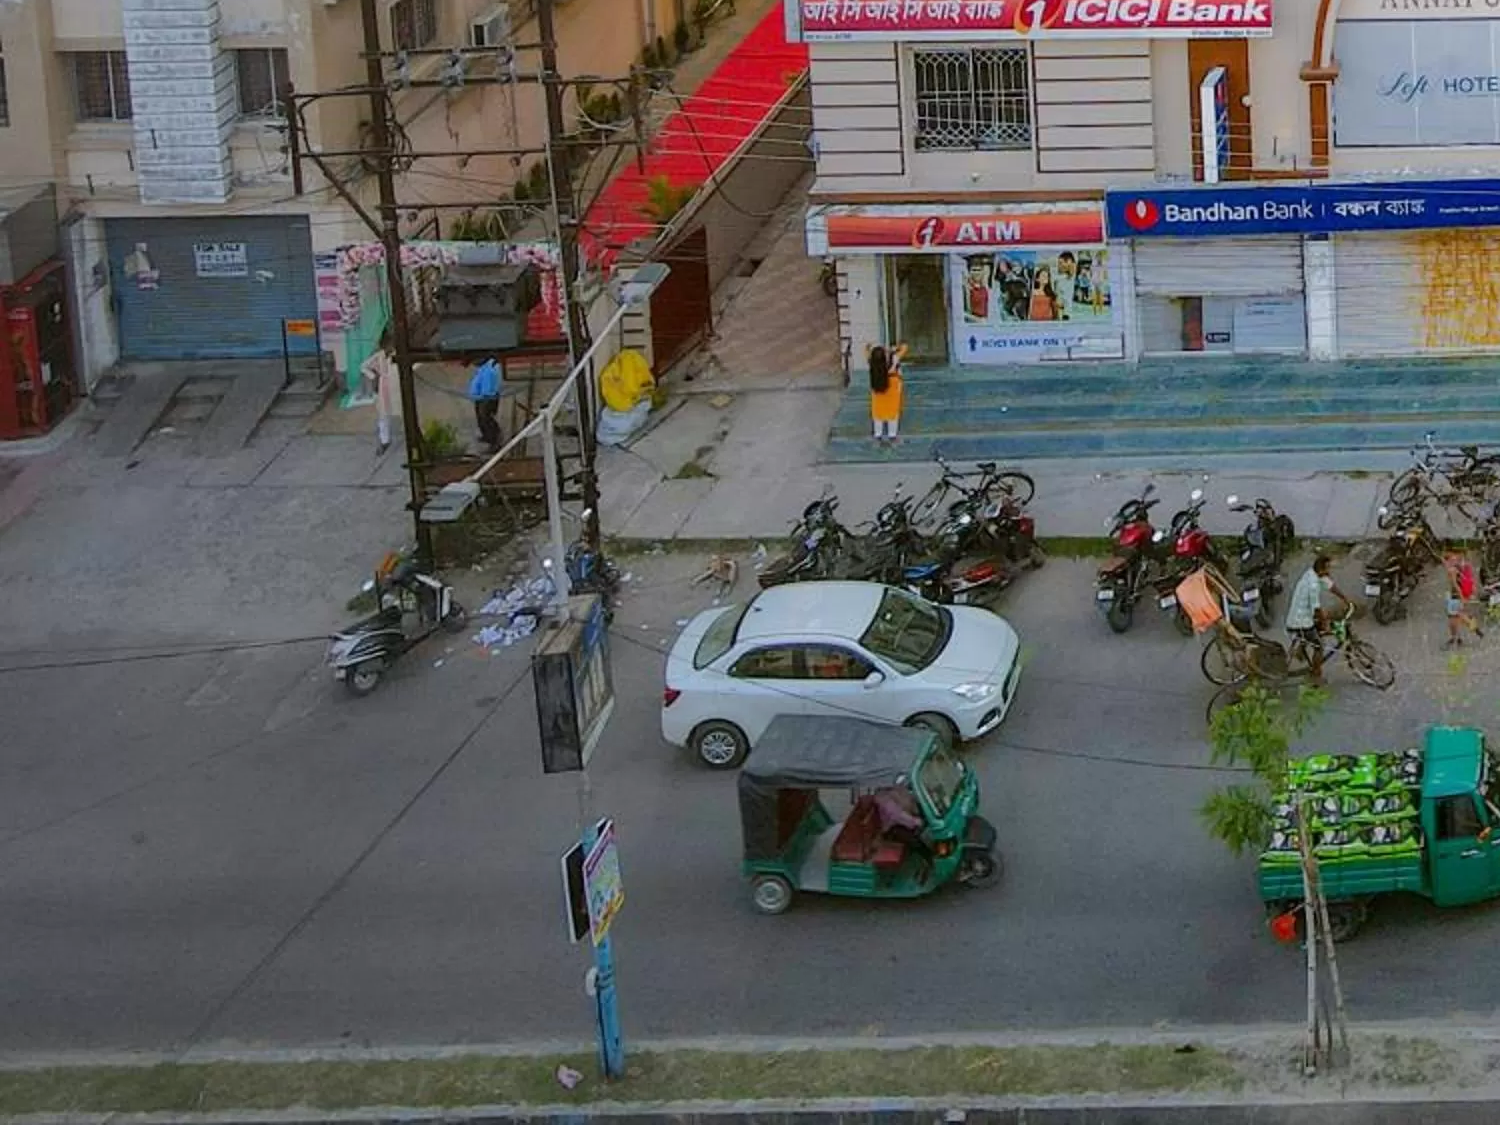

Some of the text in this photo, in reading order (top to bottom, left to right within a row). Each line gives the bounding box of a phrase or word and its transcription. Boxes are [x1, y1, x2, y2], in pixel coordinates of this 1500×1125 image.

[1165, 198, 1314, 222] Bandhan Bank
[1334, 200, 1380, 217] বন্ধন
[955, 219, 1021, 243] ATM
